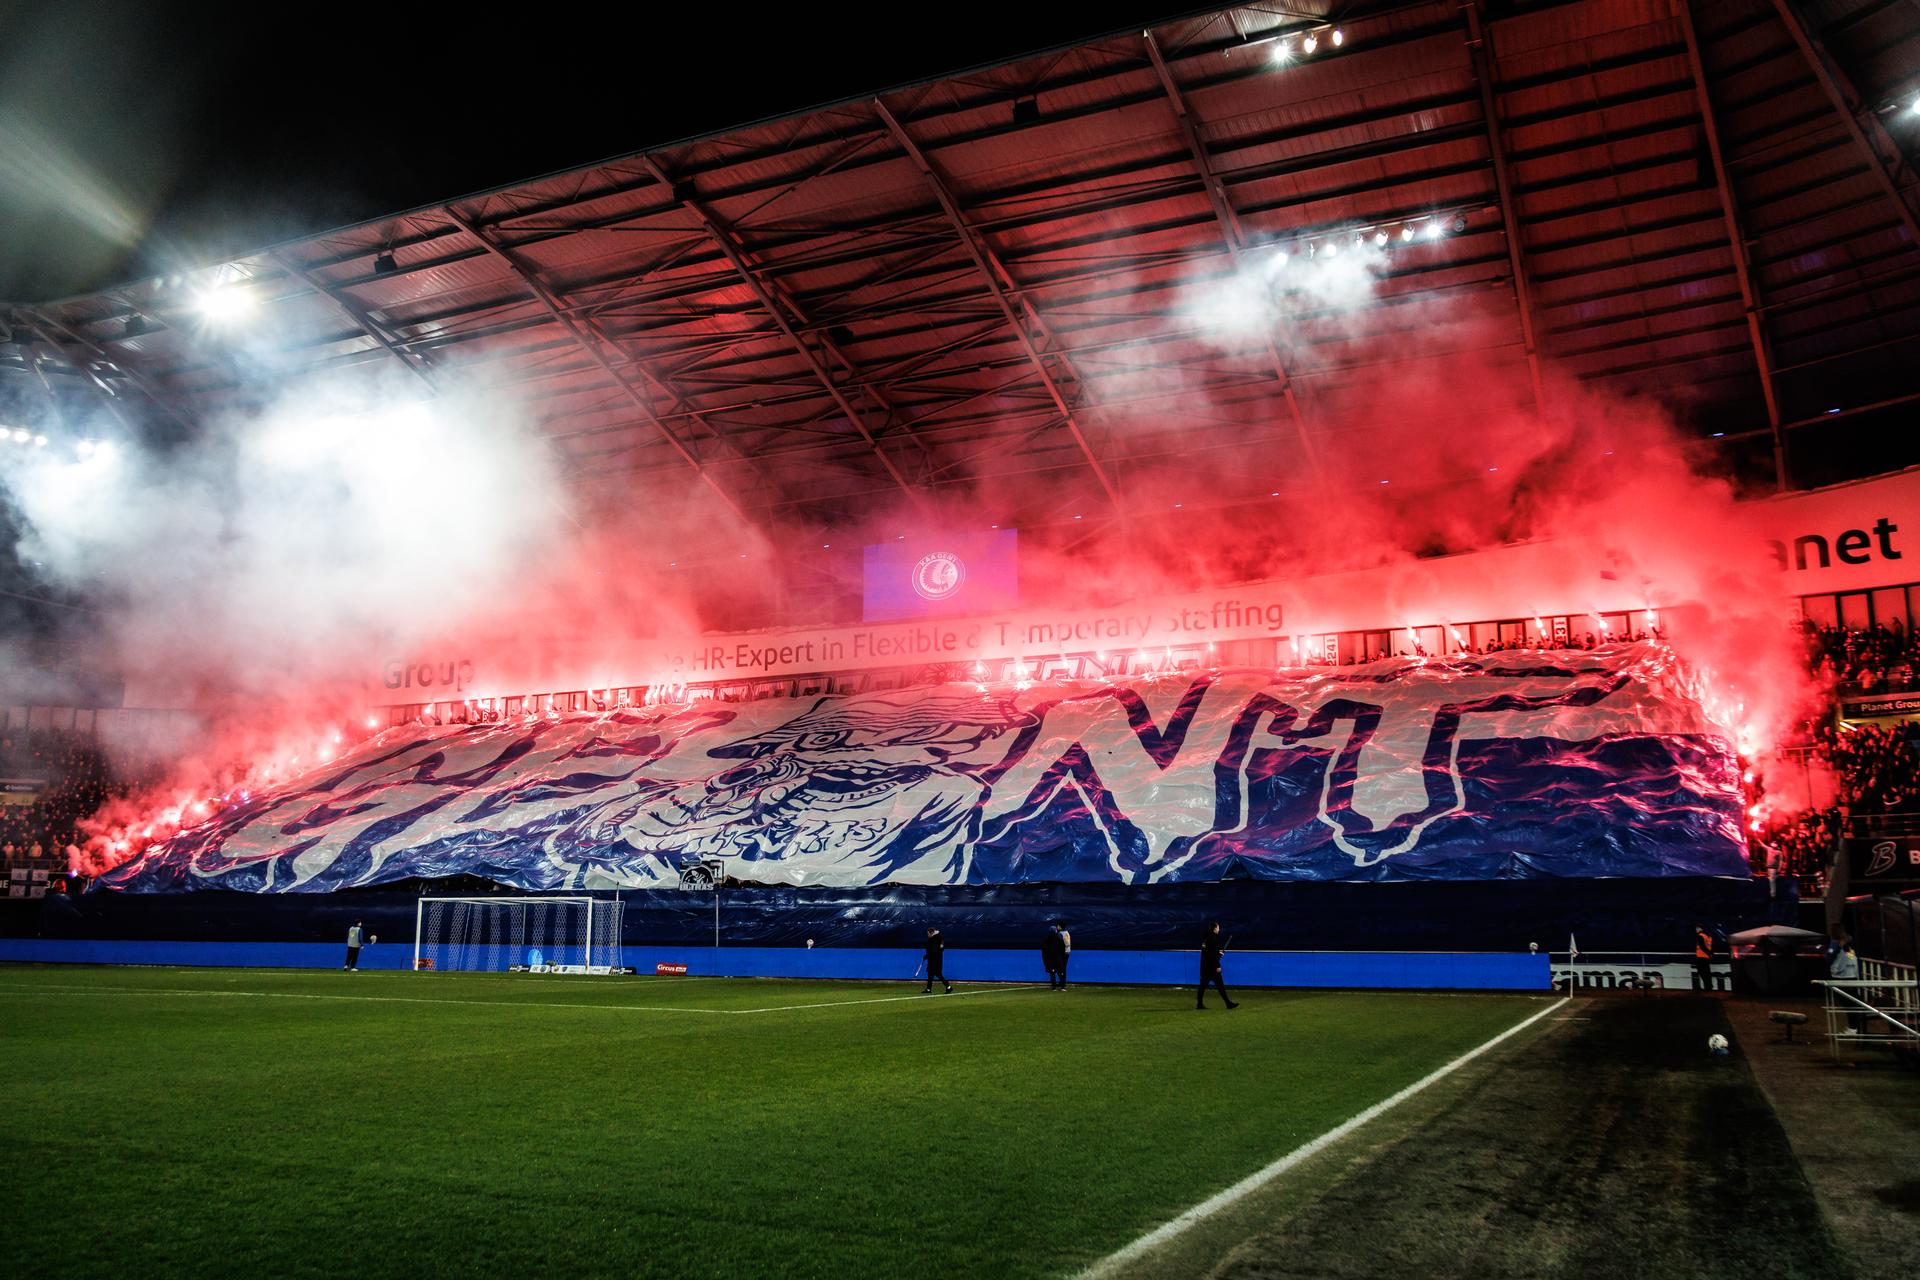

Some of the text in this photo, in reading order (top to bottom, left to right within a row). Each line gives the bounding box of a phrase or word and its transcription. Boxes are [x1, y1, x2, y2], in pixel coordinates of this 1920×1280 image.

[694, 641, 814, 672] HR-Expert
[822, 637, 844, 661] in
[853, 626, 957, 658] Flexible
[1861, 702, 1893, 712] Planet
[657, 963, 676, 972] Circus
[1551, 970, 1665, 991] aman
